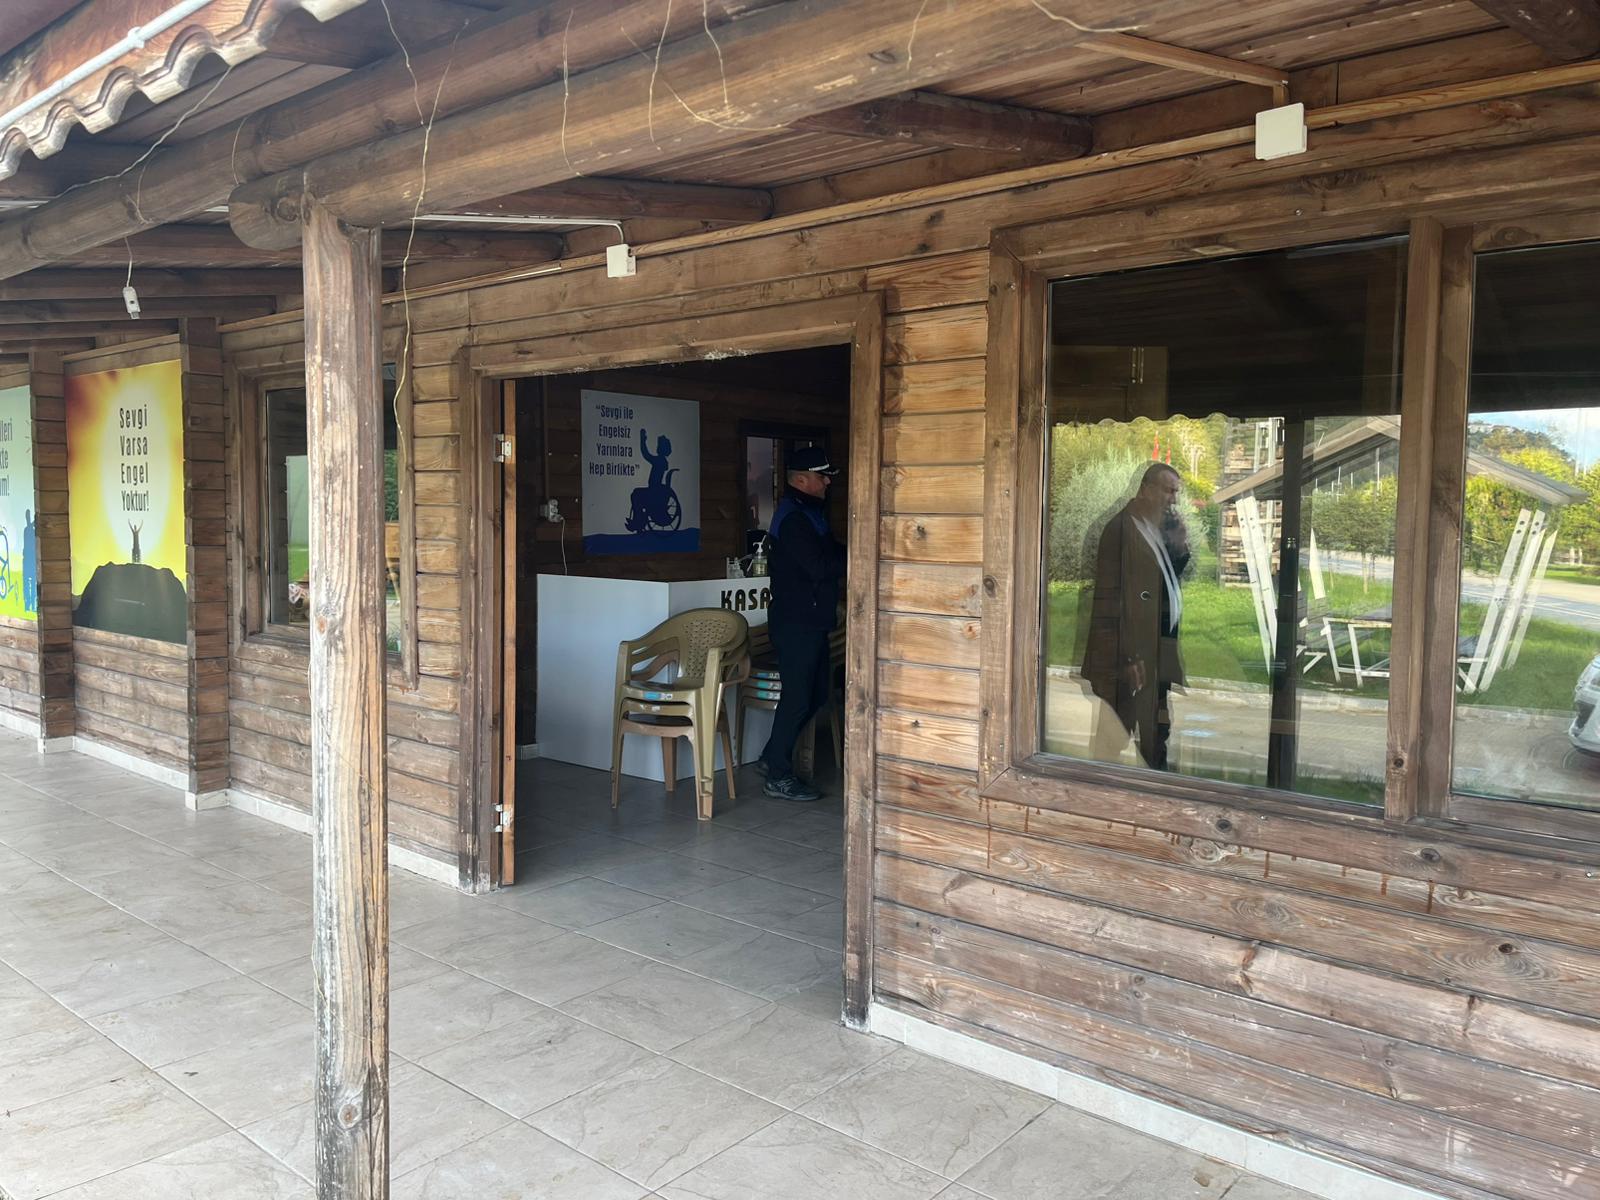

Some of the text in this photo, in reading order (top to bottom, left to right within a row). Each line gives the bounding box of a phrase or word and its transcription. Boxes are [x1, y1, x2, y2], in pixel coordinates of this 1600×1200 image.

[119, 404, 147, 429] Sevgi
[623, 407, 634, 420] ile
[598, 424, 631, 438] Engelsiz
[120, 436, 148, 456] Varsa
[121, 461, 149, 486] Engel
[589, 462, 605, 477] Hep
[121, 490, 149, 512] Yoktur!
[721, 587, 771, 611] KASA
